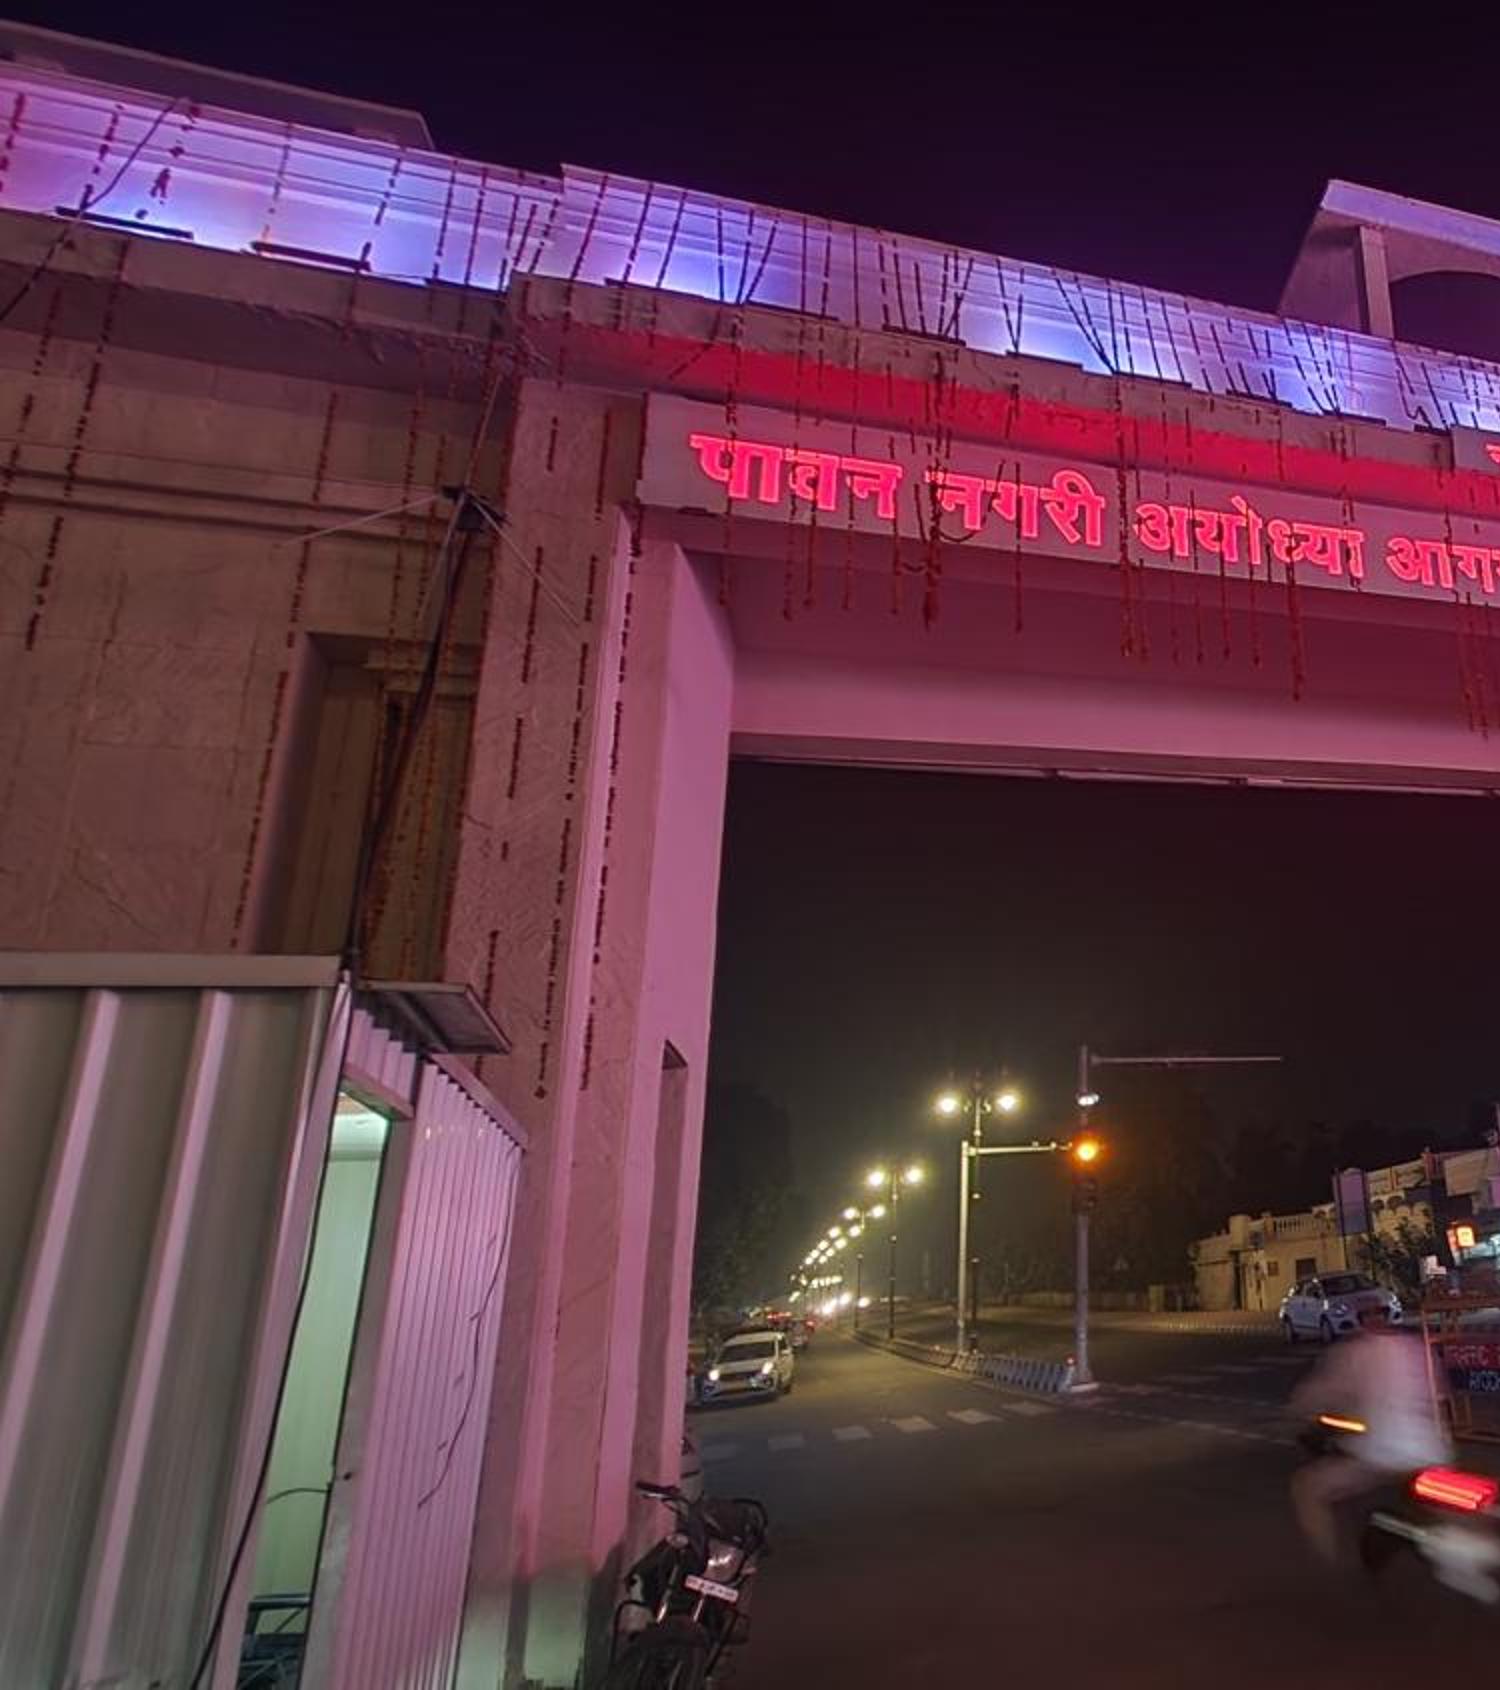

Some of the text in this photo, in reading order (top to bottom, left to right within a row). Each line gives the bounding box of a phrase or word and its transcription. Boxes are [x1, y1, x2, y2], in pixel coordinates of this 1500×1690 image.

[690, 433, 902, 519] पावन
[925, 469, 1105, 547] नगरी
[1134, 497, 1365, 578] अयोध्या
